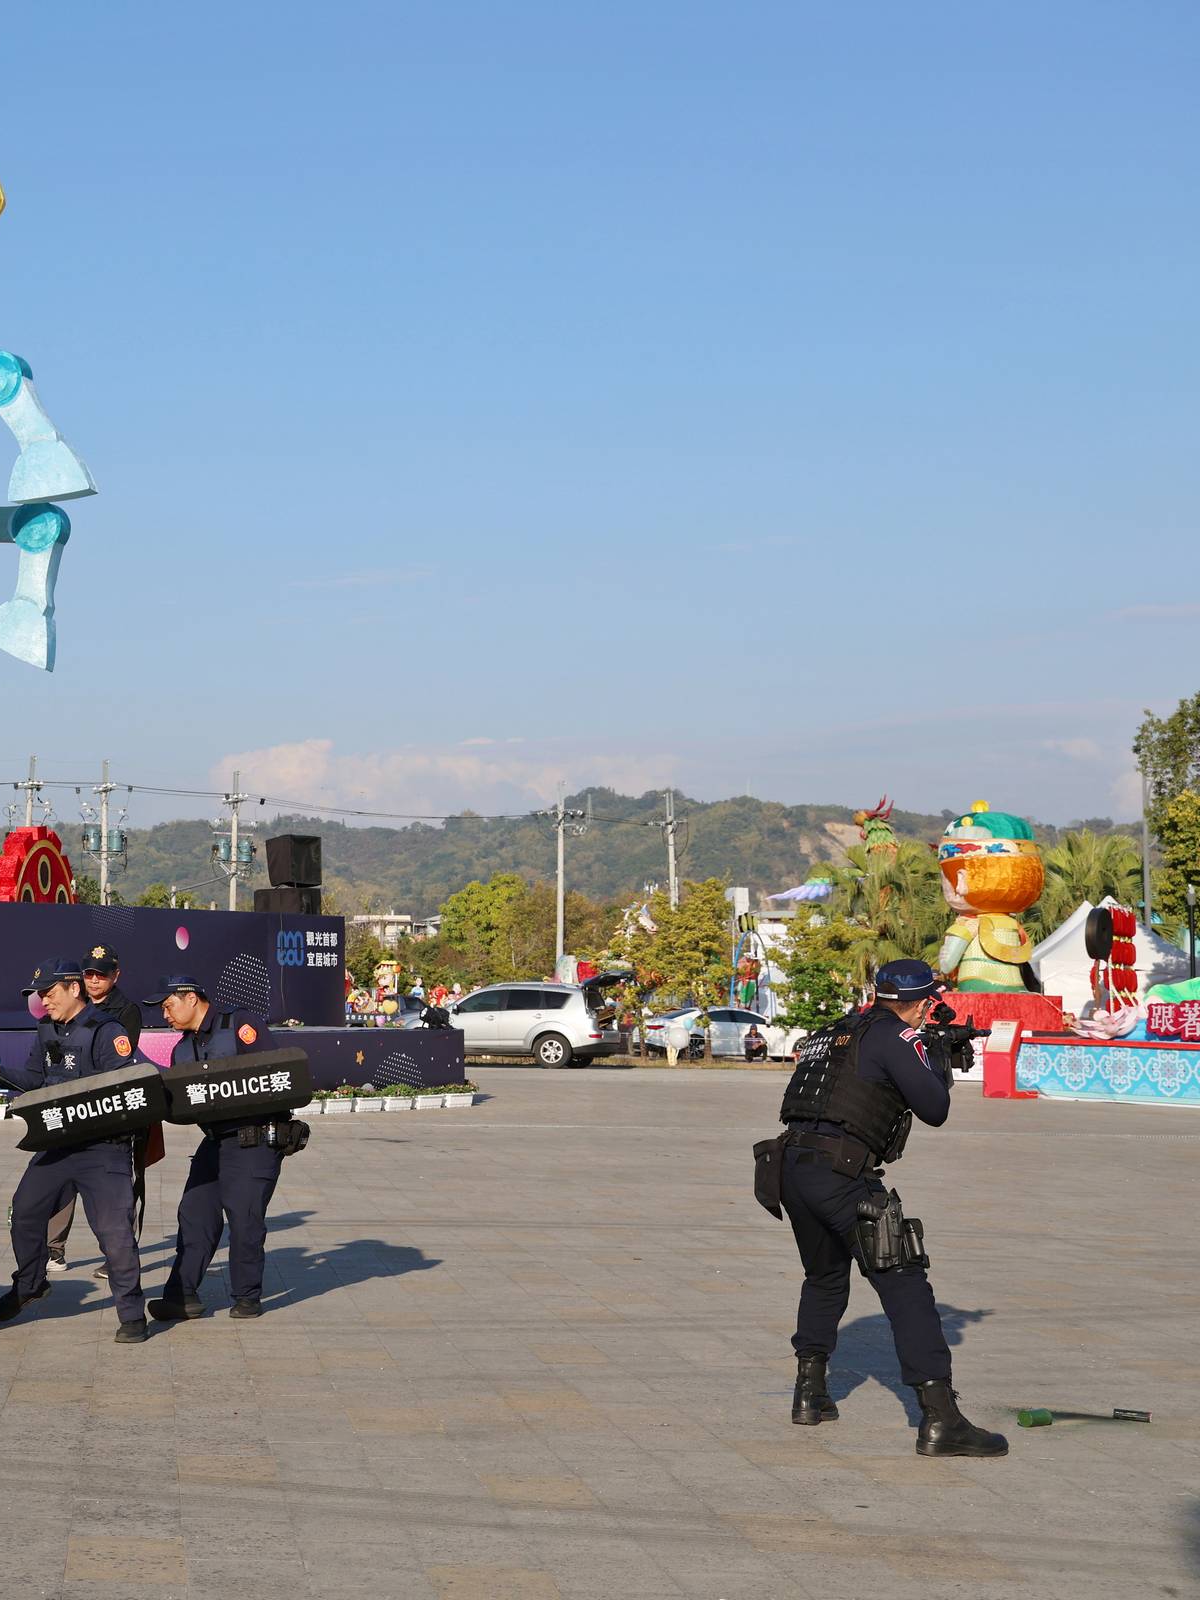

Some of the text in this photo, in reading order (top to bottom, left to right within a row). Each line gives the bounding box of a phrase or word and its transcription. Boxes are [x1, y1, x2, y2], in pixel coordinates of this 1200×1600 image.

[306, 931, 338, 947] 觀光首都
[306, 952, 338, 967] 宜居城市
[1151, 1002, 1200, 1037] 跟著
[835, 1036, 851, 1046] 007
[186, 1071, 291, 1105] 警 POLICE 察
[41, 1087, 147, 1131] 警 POLICE 察
